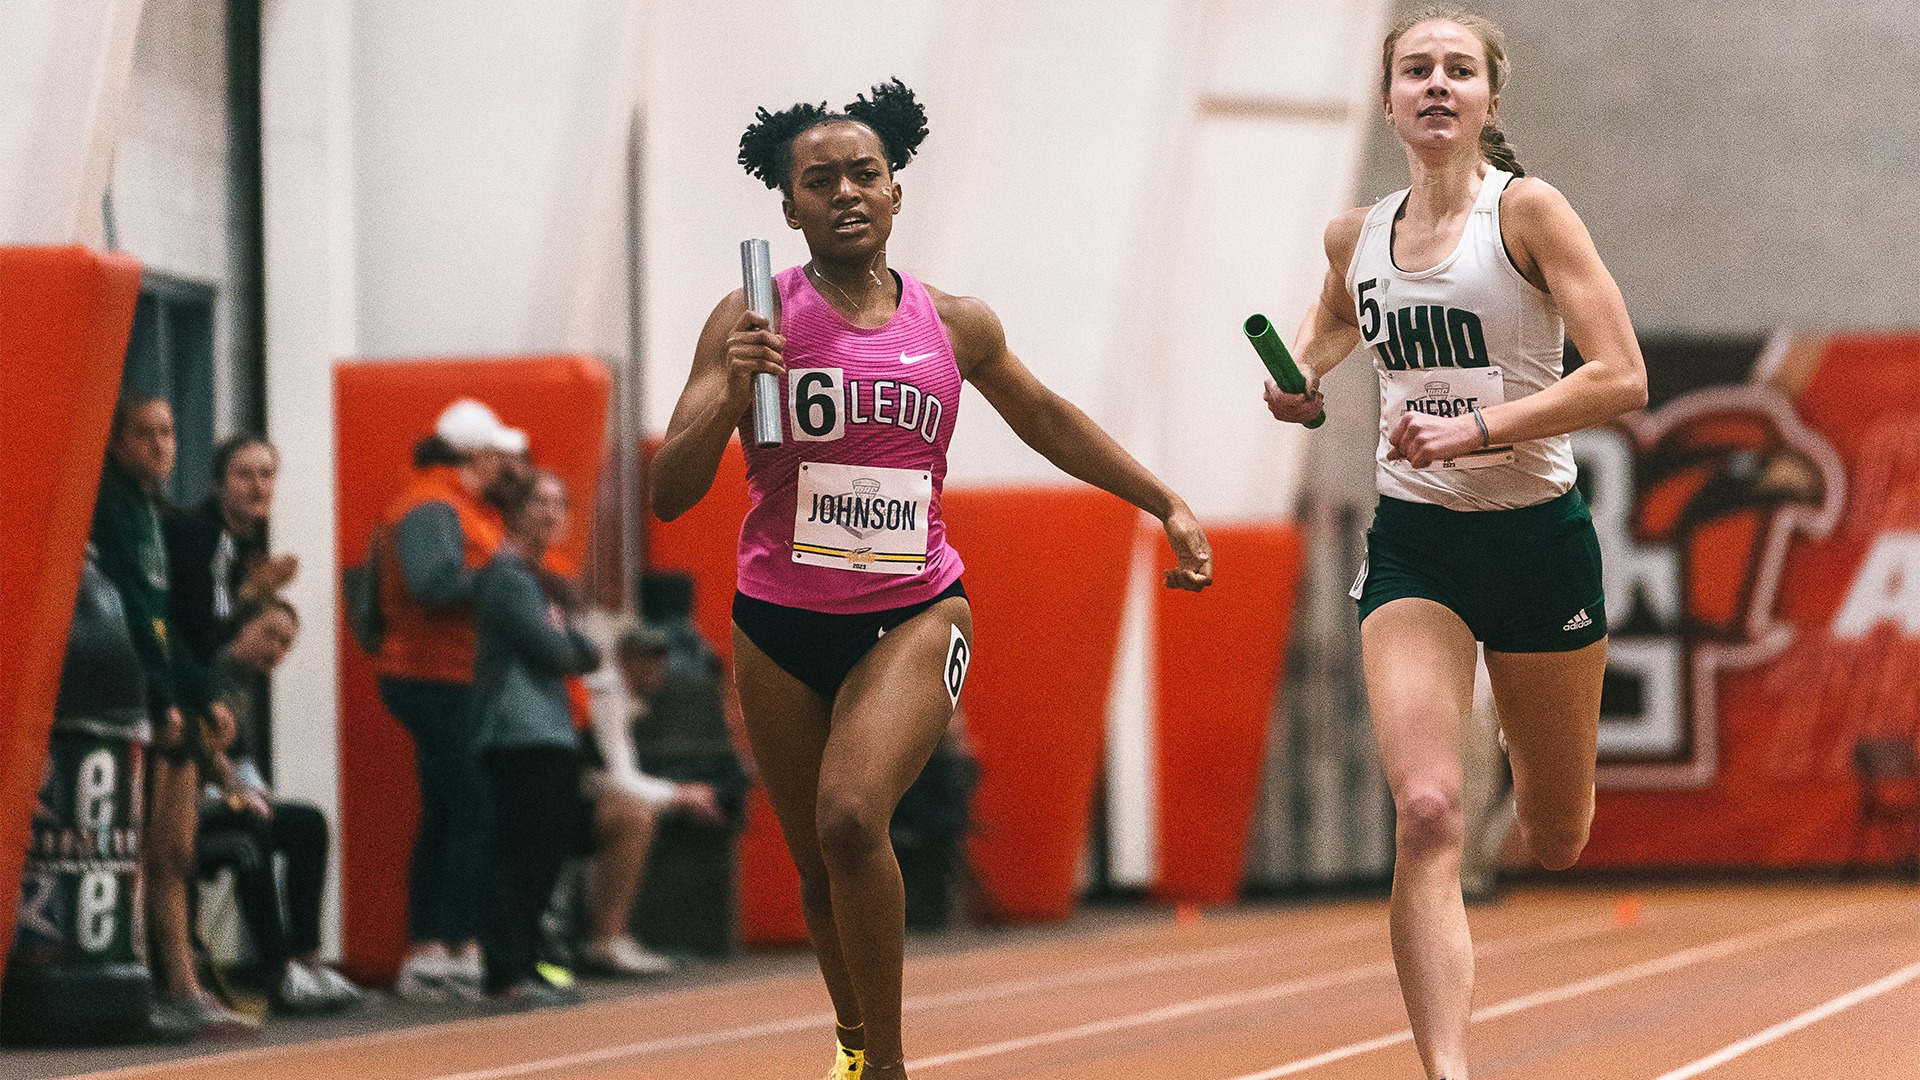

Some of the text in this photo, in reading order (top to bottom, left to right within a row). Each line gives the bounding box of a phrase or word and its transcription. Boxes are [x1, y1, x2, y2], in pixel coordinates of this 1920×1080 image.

[1358, 277, 1381, 342] 5
[796, 371, 836, 437] 6
[844, 380, 942, 444] LEDO
[808, 493, 917, 531] JOHNSON
[1563, 619, 1592, 631] adidas
[948, 637, 967, 698] 6
